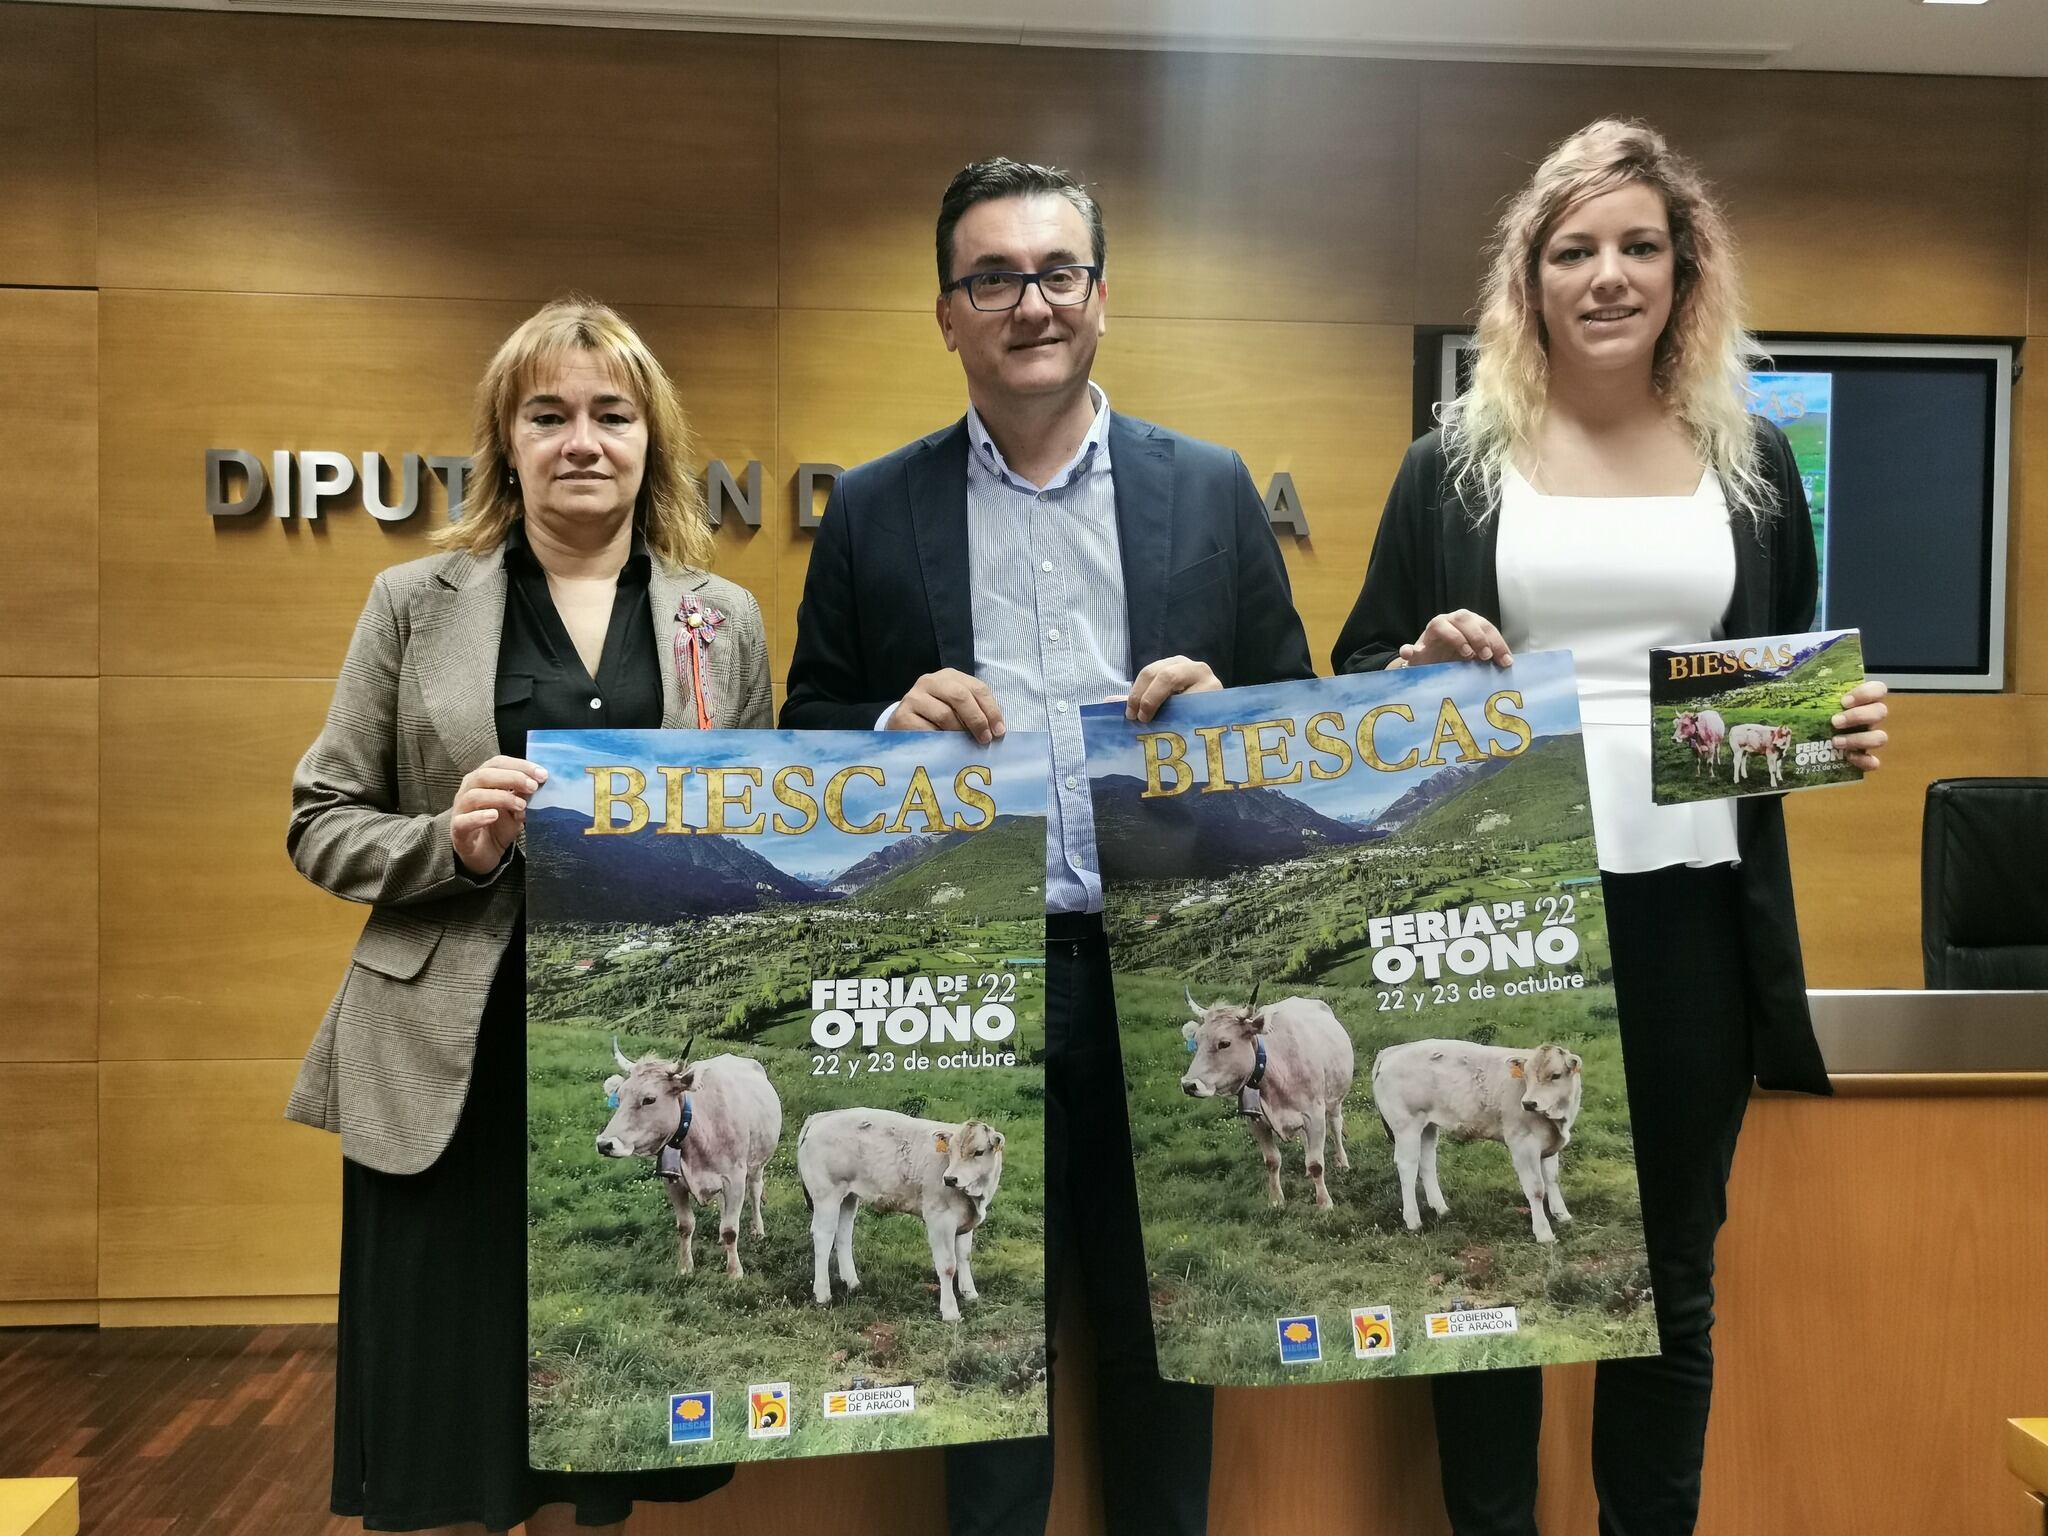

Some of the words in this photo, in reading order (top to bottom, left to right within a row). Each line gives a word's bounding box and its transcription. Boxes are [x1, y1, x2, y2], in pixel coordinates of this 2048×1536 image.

[1668, 643, 1794, 681] BIESCAS
[1136, 690, 1532, 799] BIESCAS
[584, 765, 997, 835] BIESCAS
[1368, 905, 1497, 949] FERIA
[1492, 900, 1526, 921] DE
[811, 976, 938, 1010] FERIA
[937, 974, 968, 993] DE
[1376, 990, 1405, 1012] 22
[1412, 992, 1425, 1012] y
[1431, 983, 1460, 1005] 23
[1468, 979, 1497, 1001] de
[1503, 970, 1585, 996] octubre
[812, 1054, 840, 1076] 22
[848, 1059, 861, 1079] y
[867, 1052, 895, 1073] 23
[903, 1050, 930, 1071] de
[937, 1047, 1017, 1070] octubre
[1449, 1311, 1504, 1324] GOBIERNO
[1450, 1323, 1465, 1333] DE
[848, 1389, 902, 1403] GOBIERNO
[848, 1402, 862, 1412] DE
